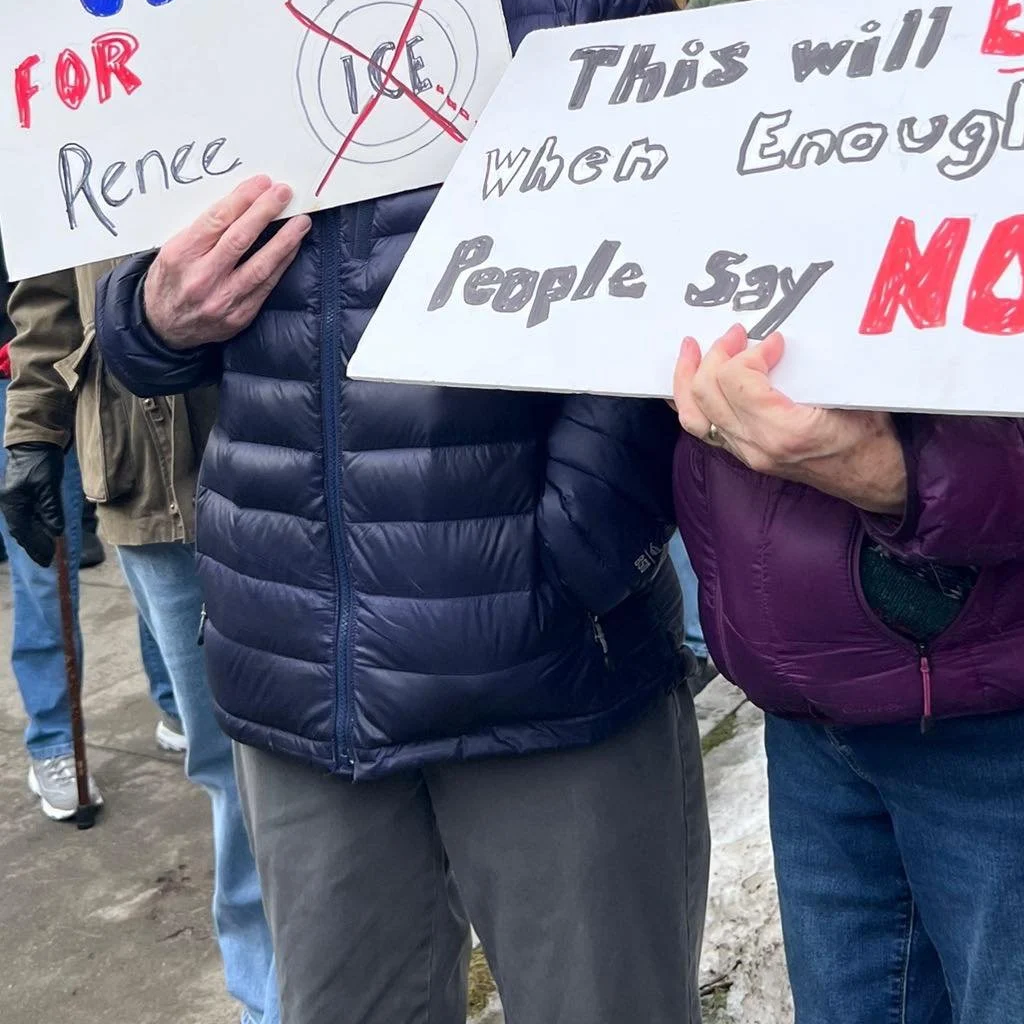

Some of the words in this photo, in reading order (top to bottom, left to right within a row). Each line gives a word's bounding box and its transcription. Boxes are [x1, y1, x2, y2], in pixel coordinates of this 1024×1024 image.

[14, 31, 142, 129] FOR
[340, 35, 433, 115] ICE
[567, 38, 750, 110] This
[791, 5, 952, 84] will
[57, 136, 243, 237] Renee
[481, 136, 669, 201] When
[427, 235, 647, 329] People
[685, 250, 834, 341] Say
